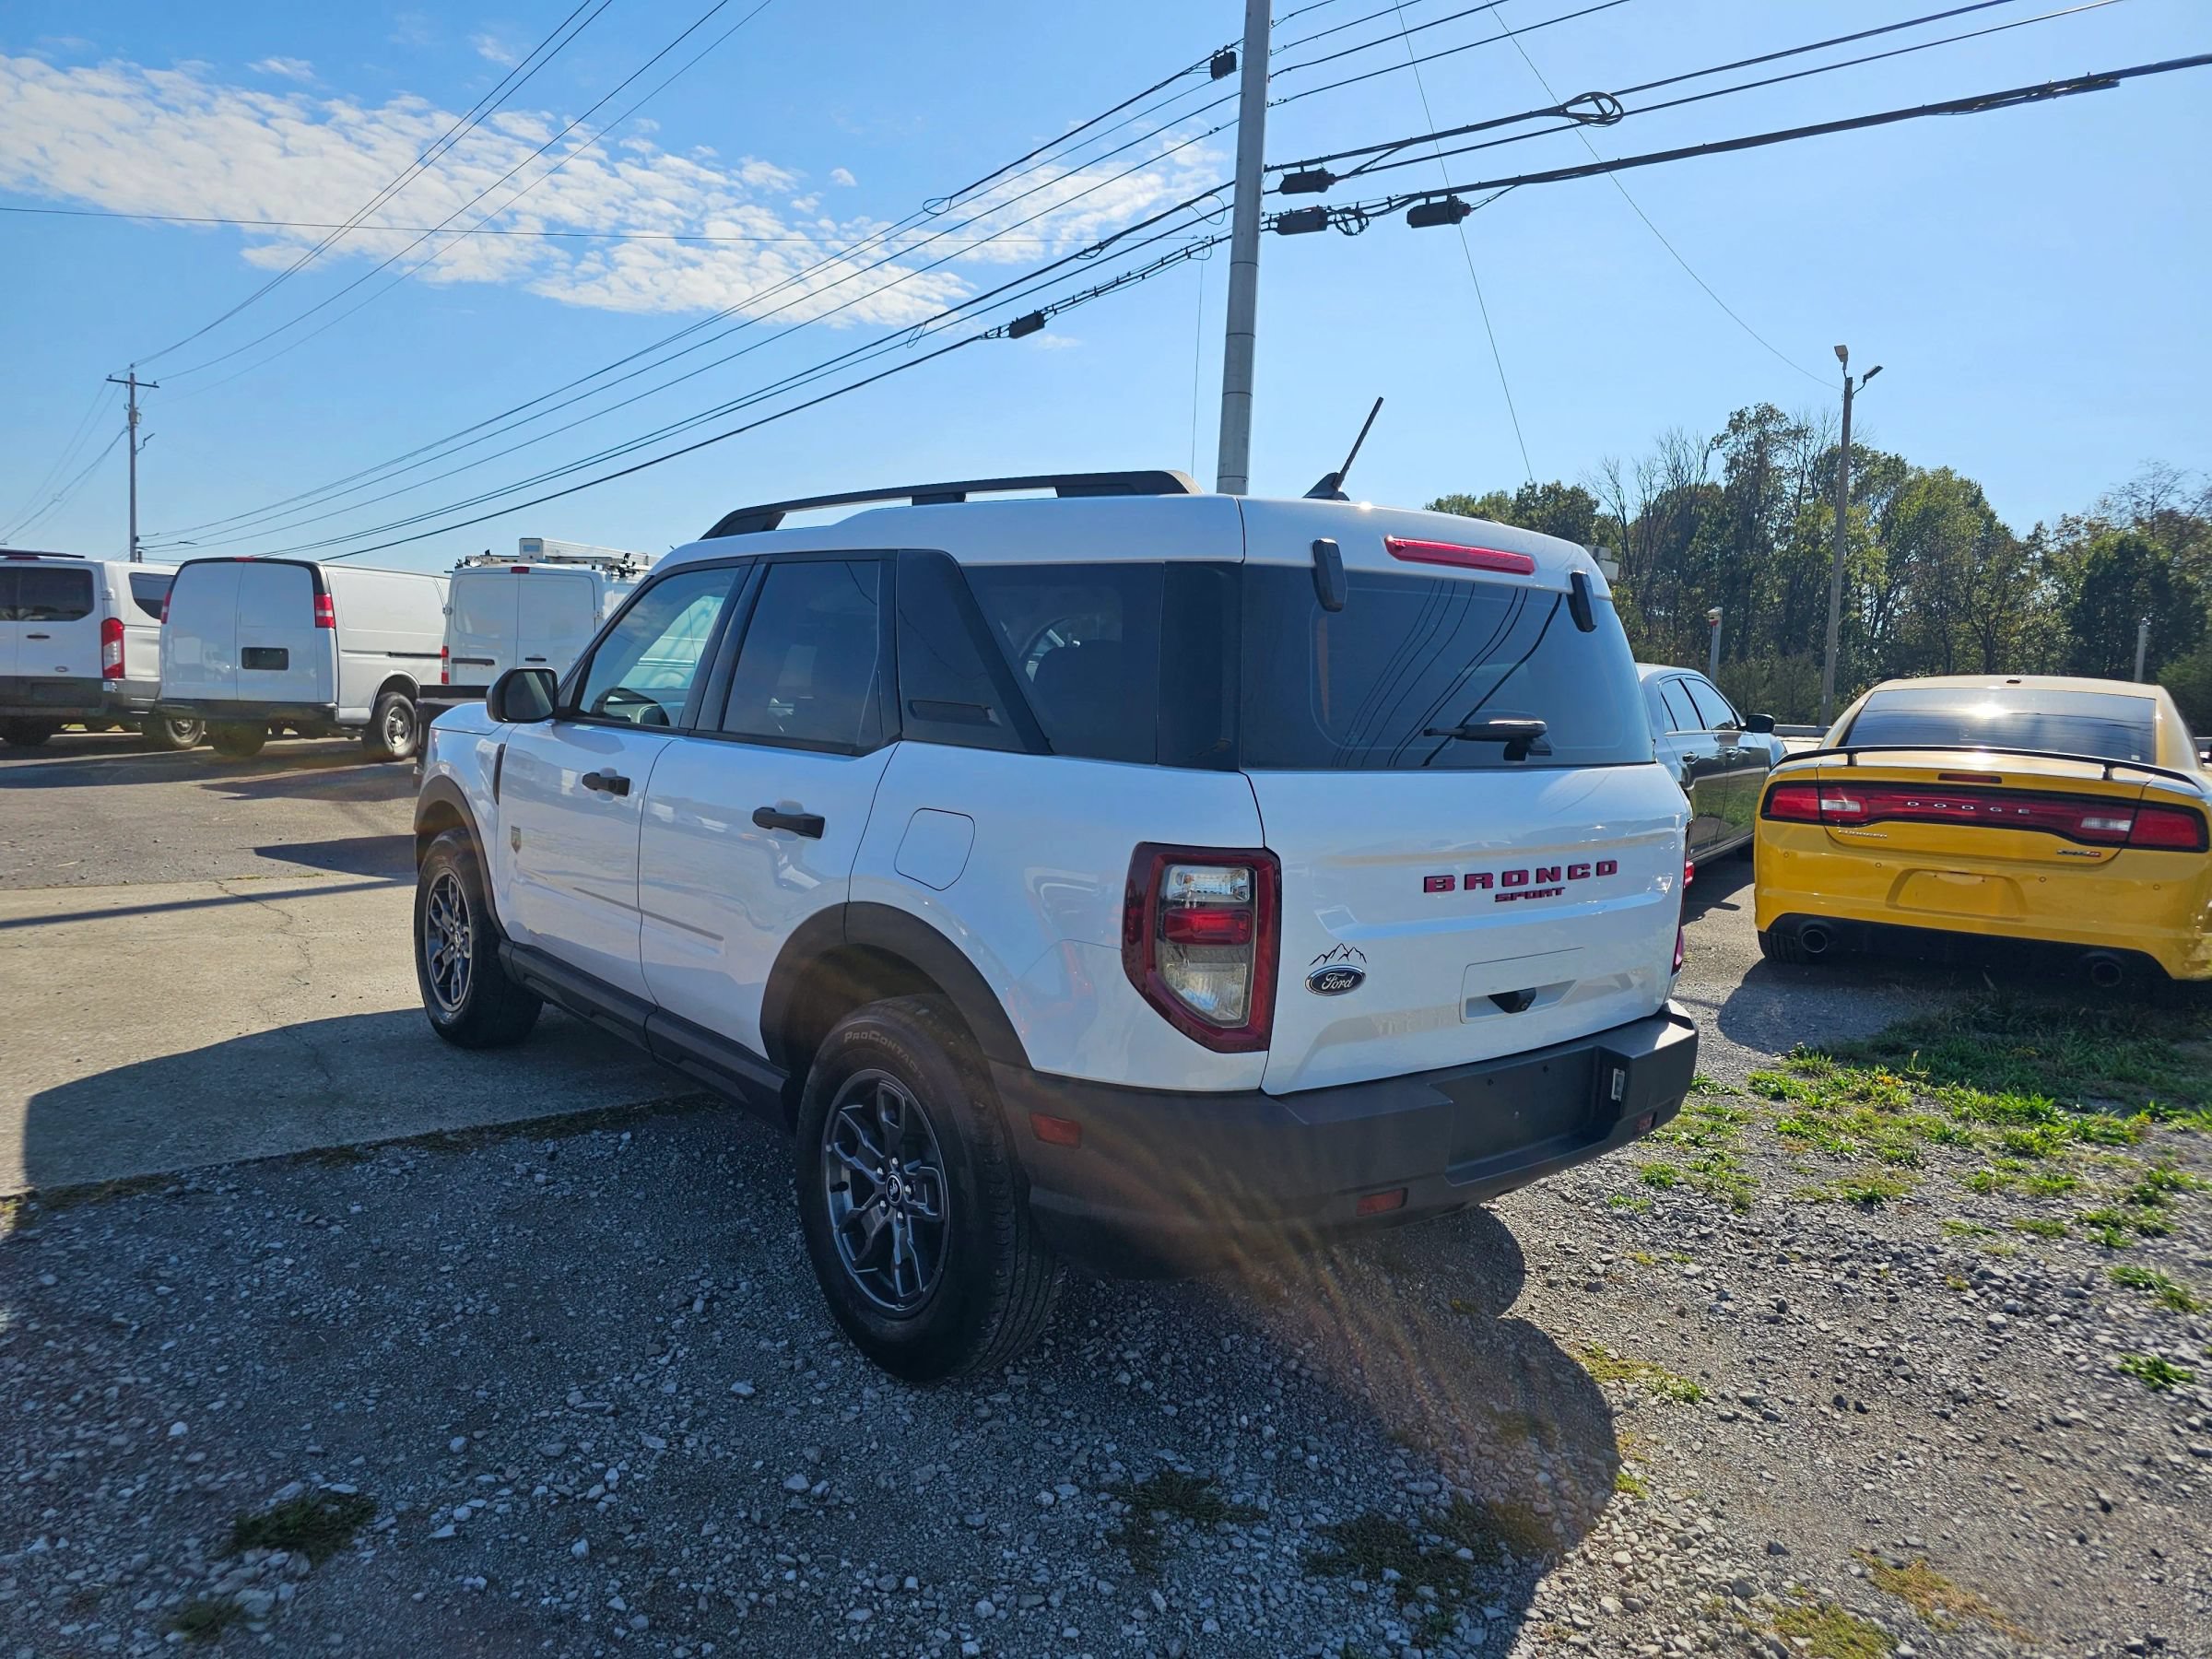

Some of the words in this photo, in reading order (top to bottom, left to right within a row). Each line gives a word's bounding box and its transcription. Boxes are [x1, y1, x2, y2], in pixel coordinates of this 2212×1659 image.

[1423, 859, 1618, 893] BRONCO
[1495, 887, 1565, 902] SPORT
[1322, 972, 1355, 990] Ford
